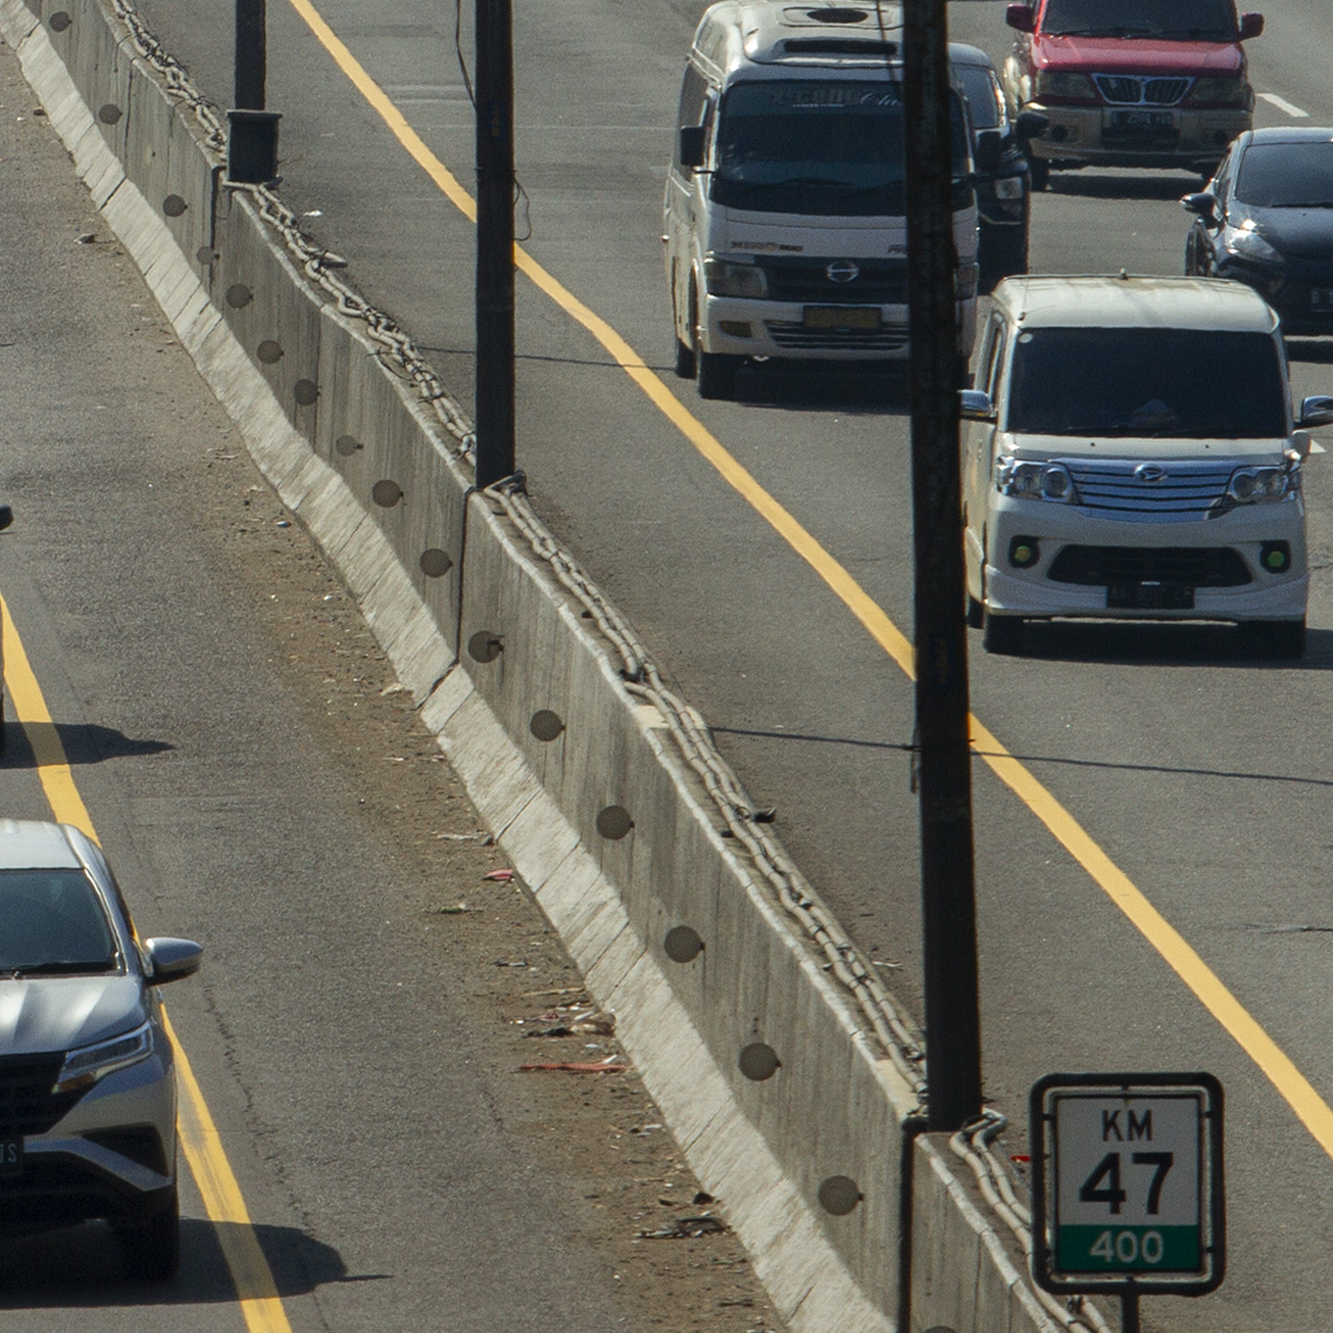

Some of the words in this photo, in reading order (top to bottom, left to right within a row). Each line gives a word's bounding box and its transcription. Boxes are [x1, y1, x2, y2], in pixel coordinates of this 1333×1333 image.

[1102, 1109, 1153, 1142] KM
[1078, 1151, 1175, 1216] 47
[1089, 1231, 1165, 1265] 400
